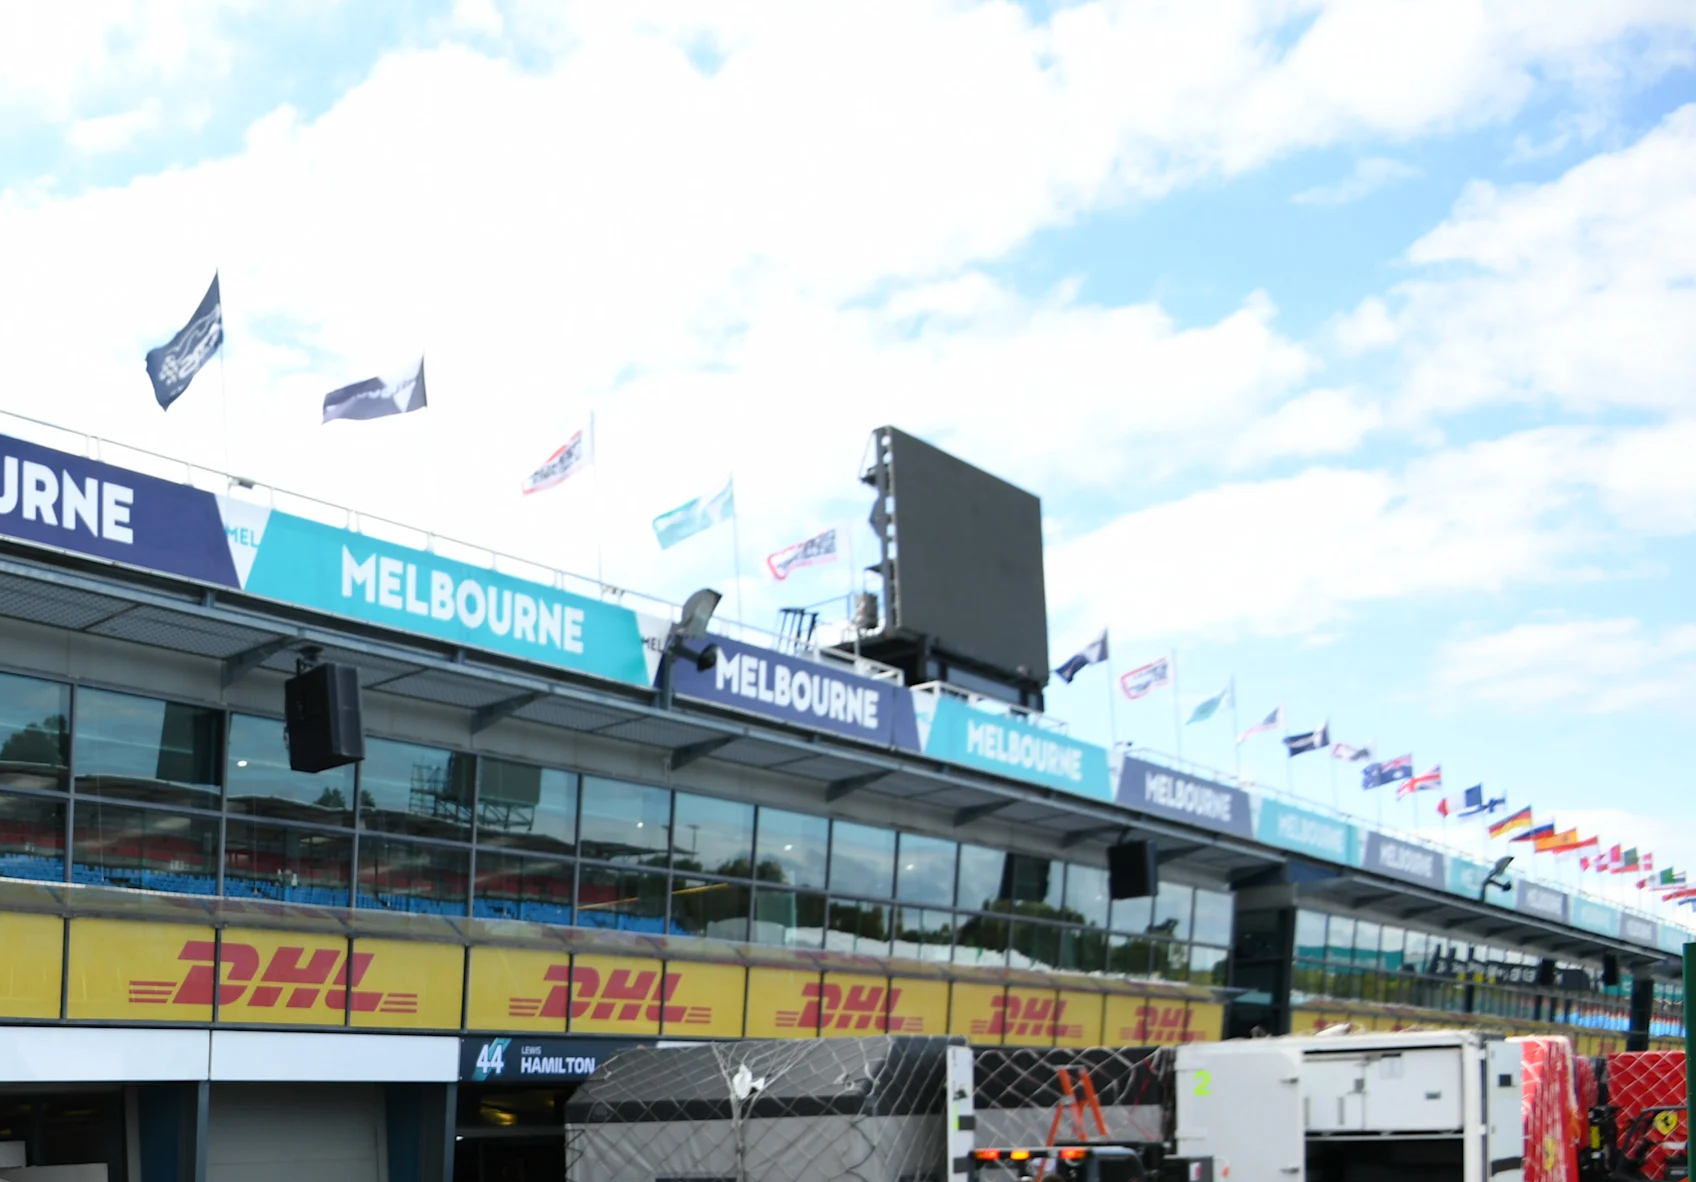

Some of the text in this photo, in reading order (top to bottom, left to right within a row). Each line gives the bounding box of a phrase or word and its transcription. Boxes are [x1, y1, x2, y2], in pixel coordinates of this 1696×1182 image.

[342, 545, 584, 654] MELBOURNE
[716, 647, 879, 730] MELBOURNE
[967, 718, 1083, 781] MELBOURNE
[1145, 770, 1232, 822] MELBOURNE
[172, 940, 383, 1014] DHL
[540, 964, 687, 1022] DHL
[787, 982, 906, 1031] DHL
[987, 995, 1069, 1040] DHL
[1134, 1005, 1194, 1043] DHL
[476, 1044, 504, 1074] 44
[520, 1056, 596, 1074] HAMILTON
[521, 1046, 541, 1055] LEWIS
[1193, 1069, 1211, 1096] 2
